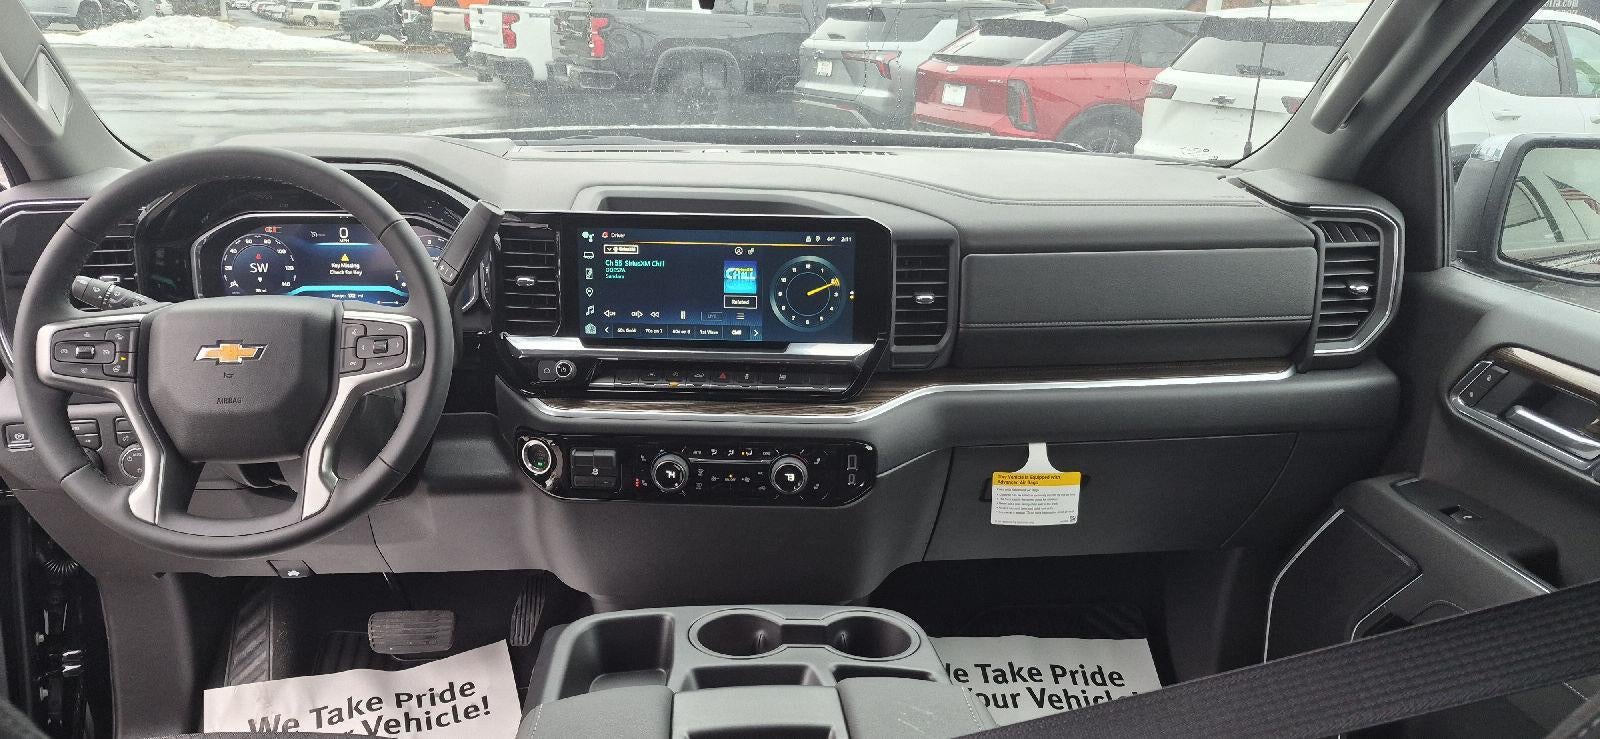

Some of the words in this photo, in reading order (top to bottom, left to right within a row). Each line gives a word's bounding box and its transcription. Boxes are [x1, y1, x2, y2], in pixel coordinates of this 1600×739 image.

[250, 263, 268, 272] SW
[973, 662, 1043, 684] Take
[1050, 664, 1126, 688] Pride
[309, 696, 383, 730] Take
[395, 681, 476, 709] Pride
[361, 695, 490, 736] Vehicle!
